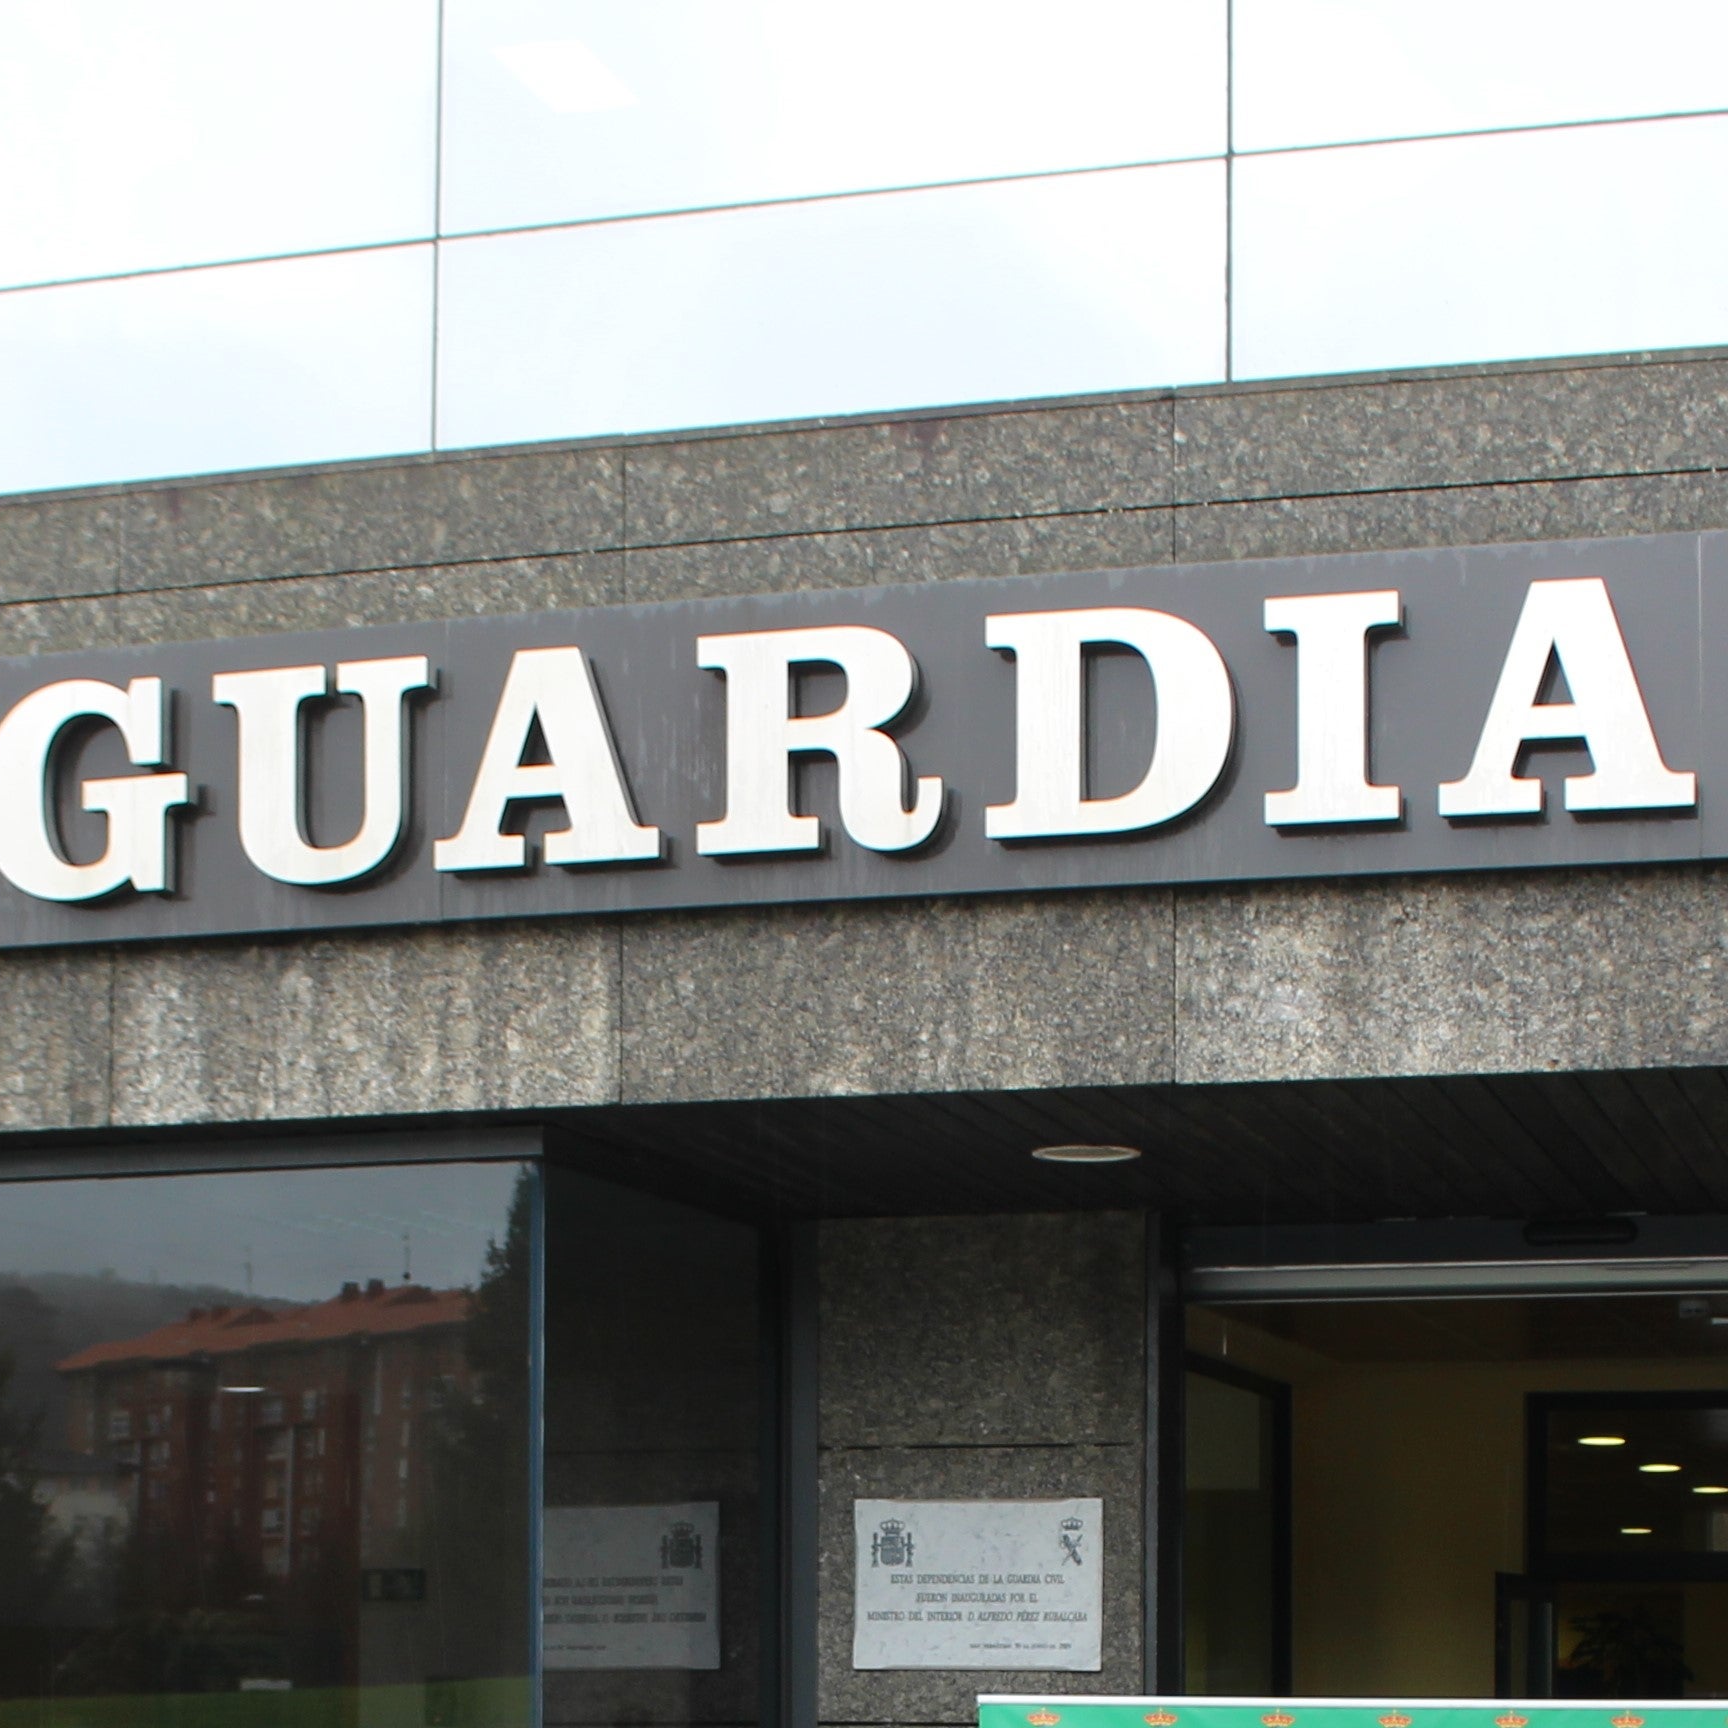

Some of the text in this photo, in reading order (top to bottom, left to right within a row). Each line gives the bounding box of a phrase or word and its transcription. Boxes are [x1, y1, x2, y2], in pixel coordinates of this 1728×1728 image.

[890, 1573, 913, 1585] ESTAS
[978, 1573, 989, 1585] DE
[993, 1573, 1004, 1585] LA
[1007, 1573, 1041, 1585] GUARDIA
[1044, 1573, 1065, 1585] CIVIL
[1010, 1592, 1026, 1603] POR
[1029, 1592, 1039, 1603] EL
[867, 1611, 905, 1622] MINISTRO
[908, 1611, 923, 1622] DEL
[927, 1611, 962, 1622] INTERIOR
[977, 1611, 1013, 1622] ALFREDO
